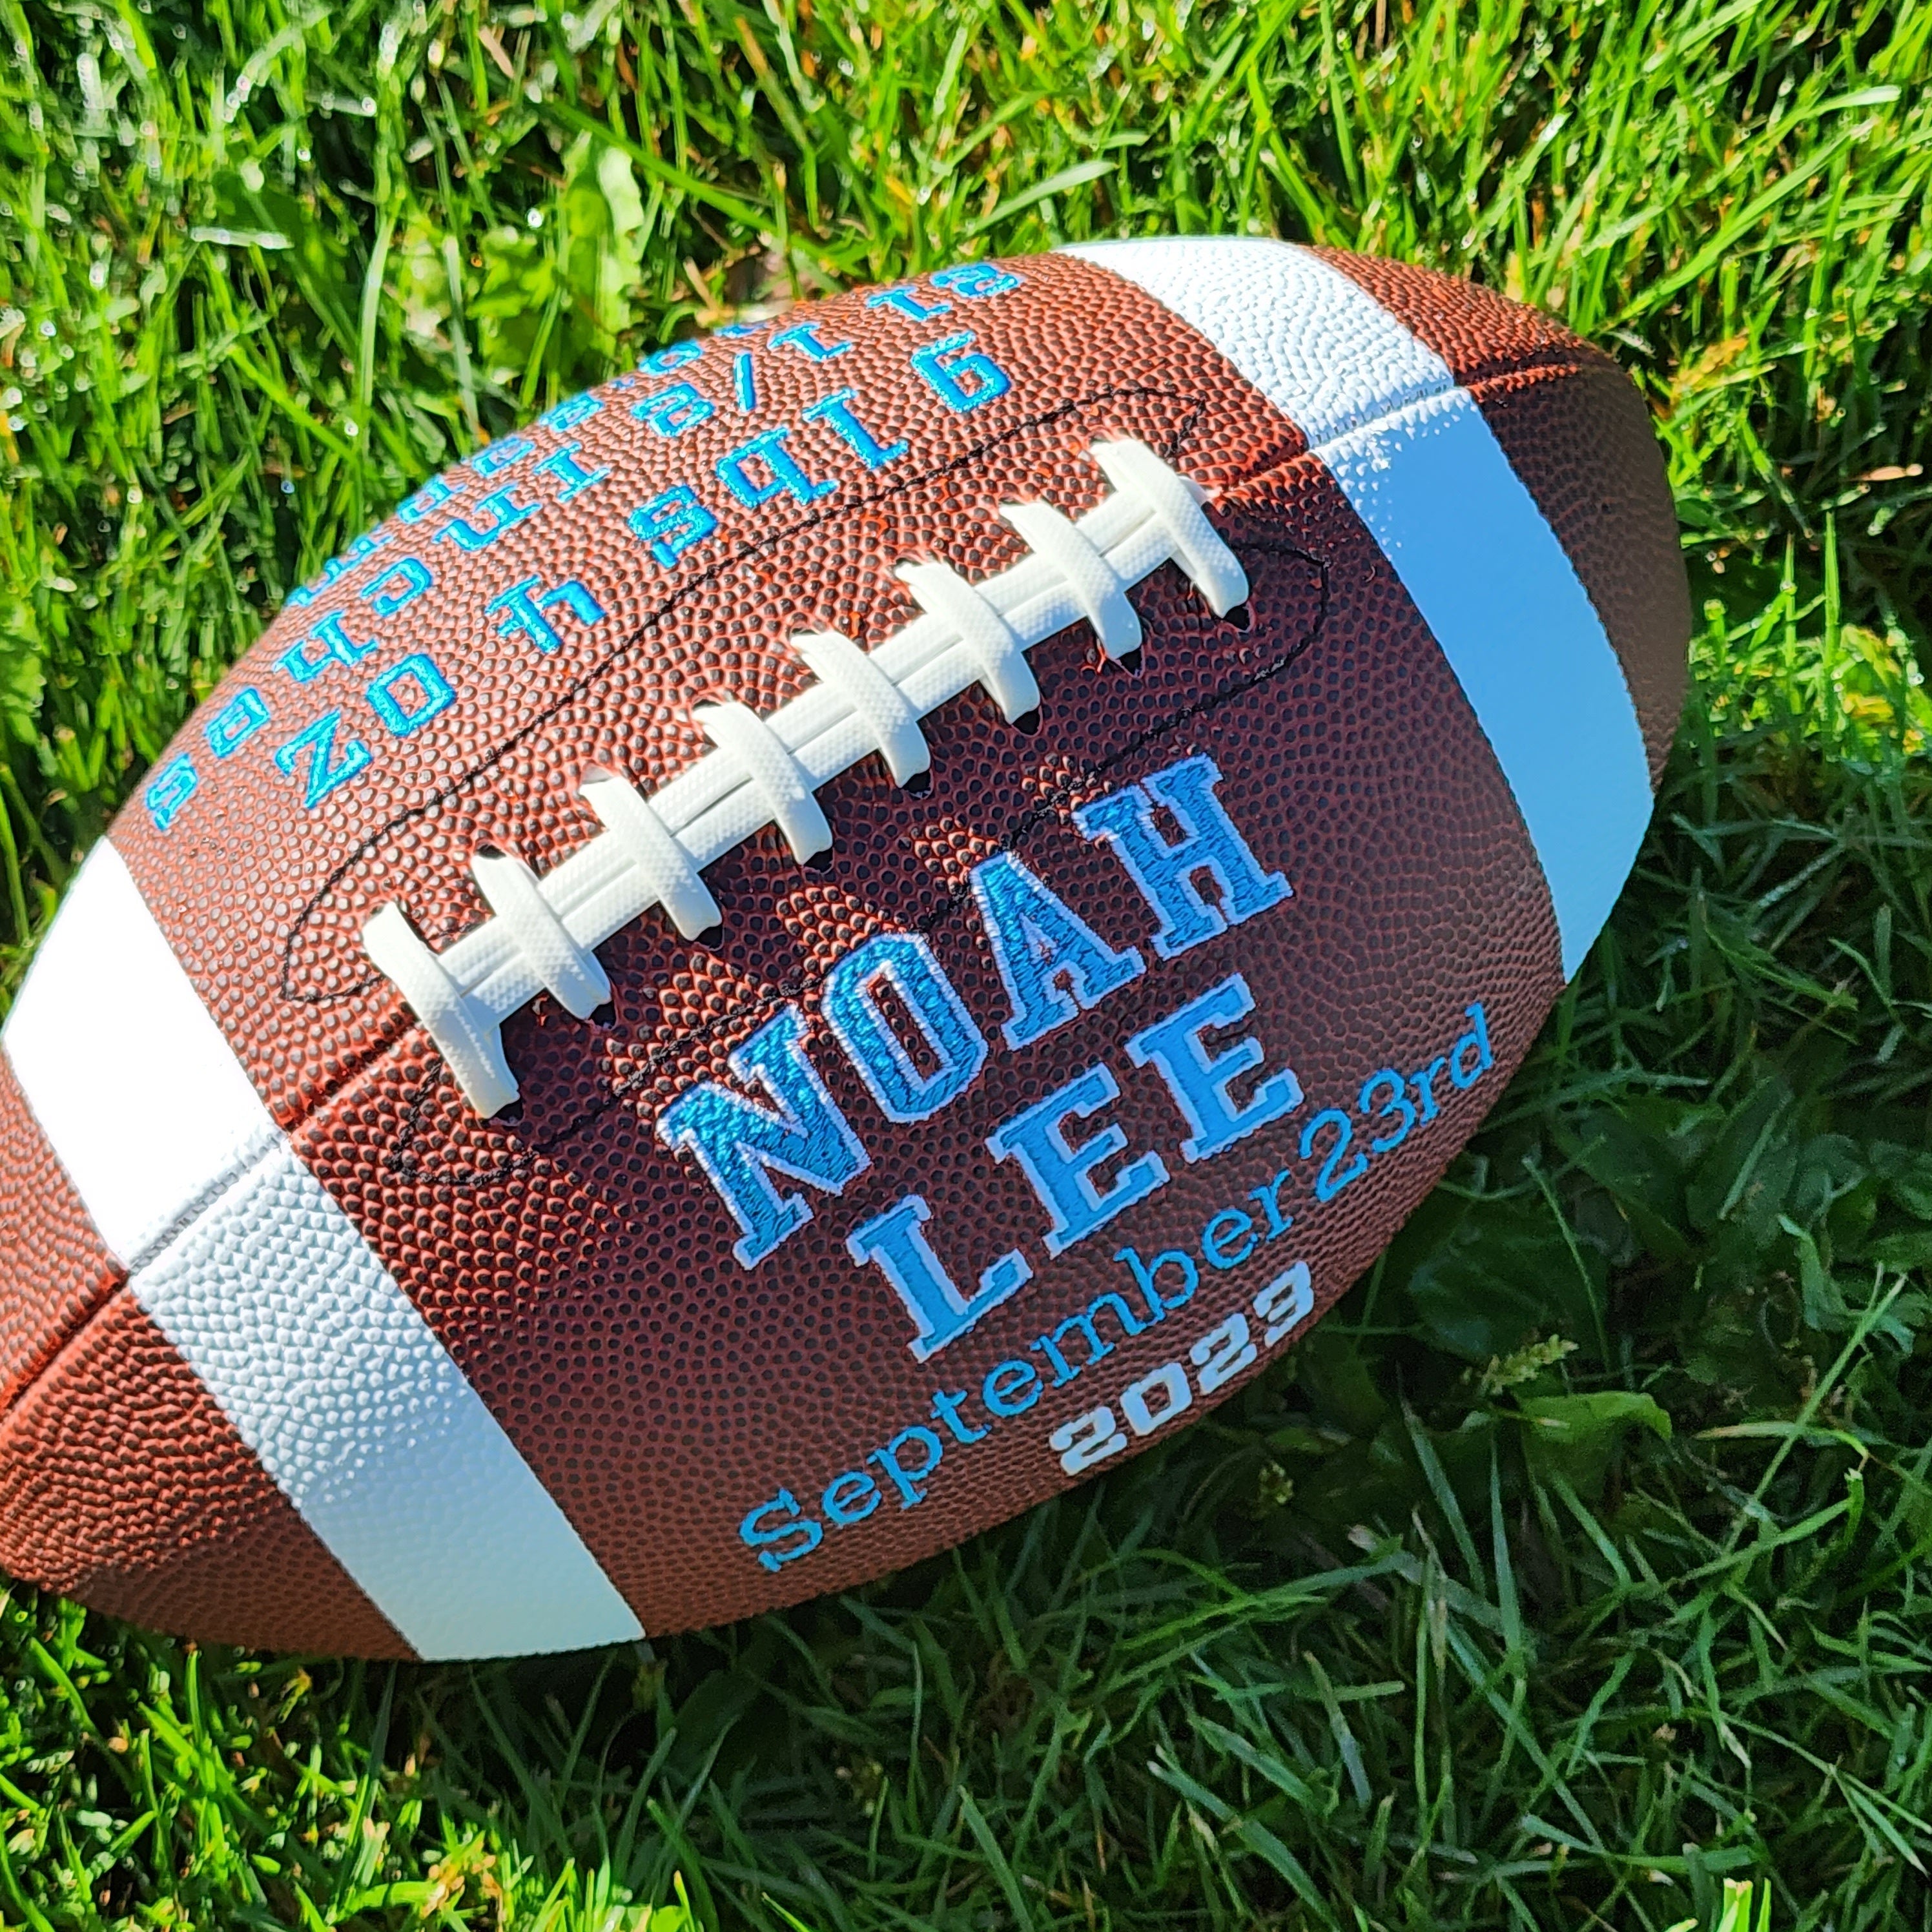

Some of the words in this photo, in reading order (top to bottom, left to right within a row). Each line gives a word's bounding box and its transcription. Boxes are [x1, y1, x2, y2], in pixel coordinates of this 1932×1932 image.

[630, 320, 853, 438] 1/2
[866, 261, 1026, 323] 21
[910, 330, 1012, 414] 9
[627, 387, 909, 570] lbs
[484, 573, 607, 655] 4
[657, 752, 1293, 1271] NOAH
[845, 972, 1306, 1364] LEE
[736, 1167, 1294, 1574] September
[1297, 1000, 1496, 1204] 23rd
[1048, 1260, 1315, 1477] 2023
